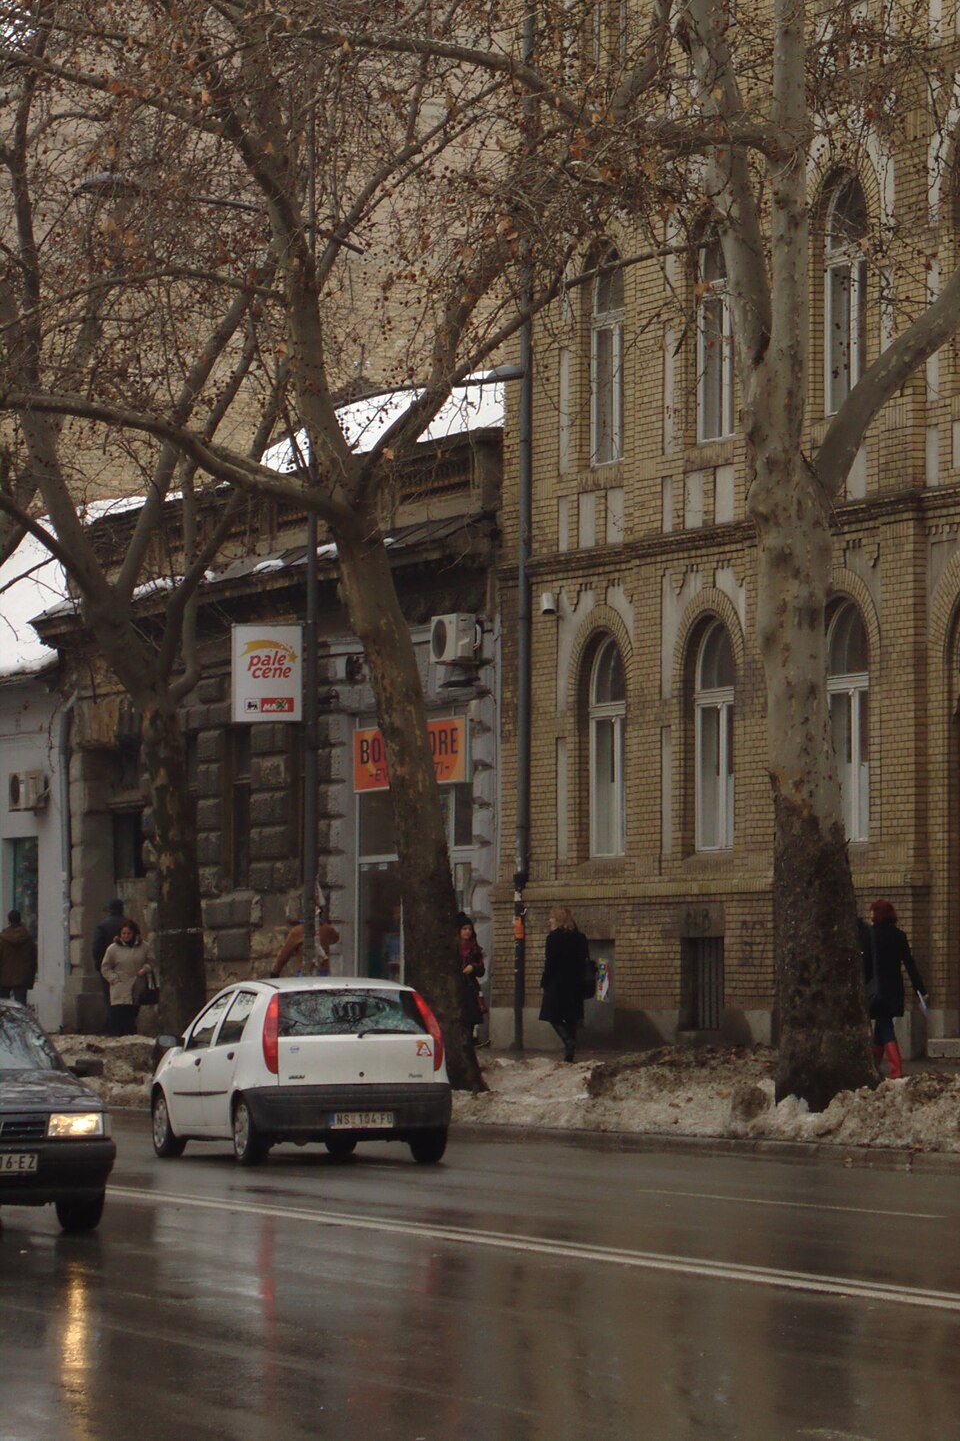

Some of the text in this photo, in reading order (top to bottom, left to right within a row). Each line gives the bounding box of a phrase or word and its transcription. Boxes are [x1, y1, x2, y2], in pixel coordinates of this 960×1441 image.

[248, 650, 287, 671] pale
[252, 666, 292, 679] cene
[336, 1114, 350, 1125] NS
